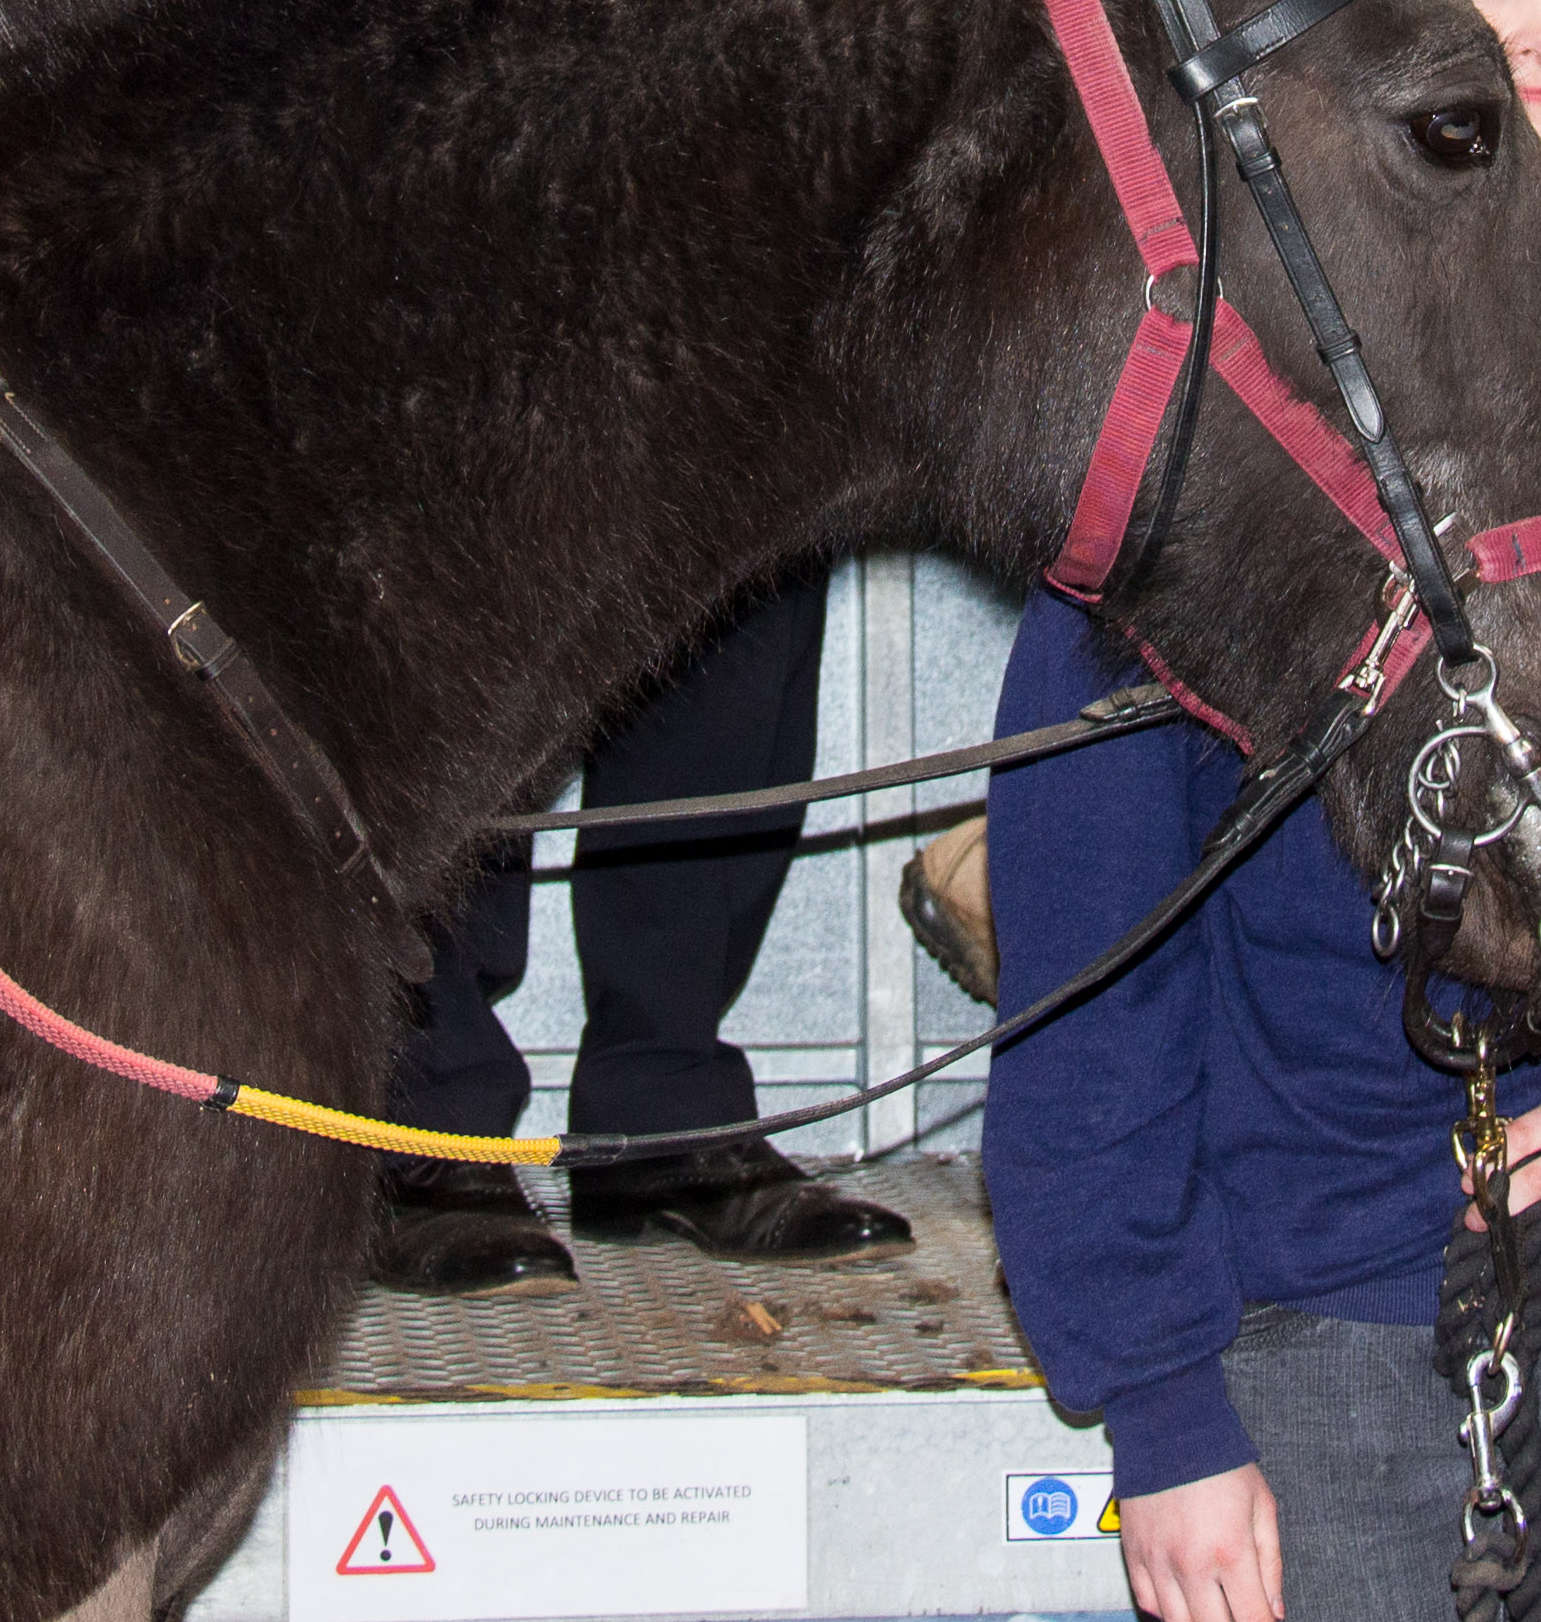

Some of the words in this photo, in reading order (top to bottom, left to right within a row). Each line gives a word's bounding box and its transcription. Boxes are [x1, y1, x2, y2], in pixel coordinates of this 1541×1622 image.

[451, 1491, 504, 1507] SAFETY
[507, 1490, 570, 1506] LOCKING
[574, 1488, 624, 1504] DEVICE
[628, 1488, 649, 1502] TO
[652, 1487, 669, 1501] BE
[673, 1485, 752, 1500] ACTIVATED
[474, 1516, 531, 1531] DURING
[535, 1512, 640, 1529] MAINTENANCE
[644, 1512, 677, 1526] AND
[680, 1510, 730, 1525] REPAIR
